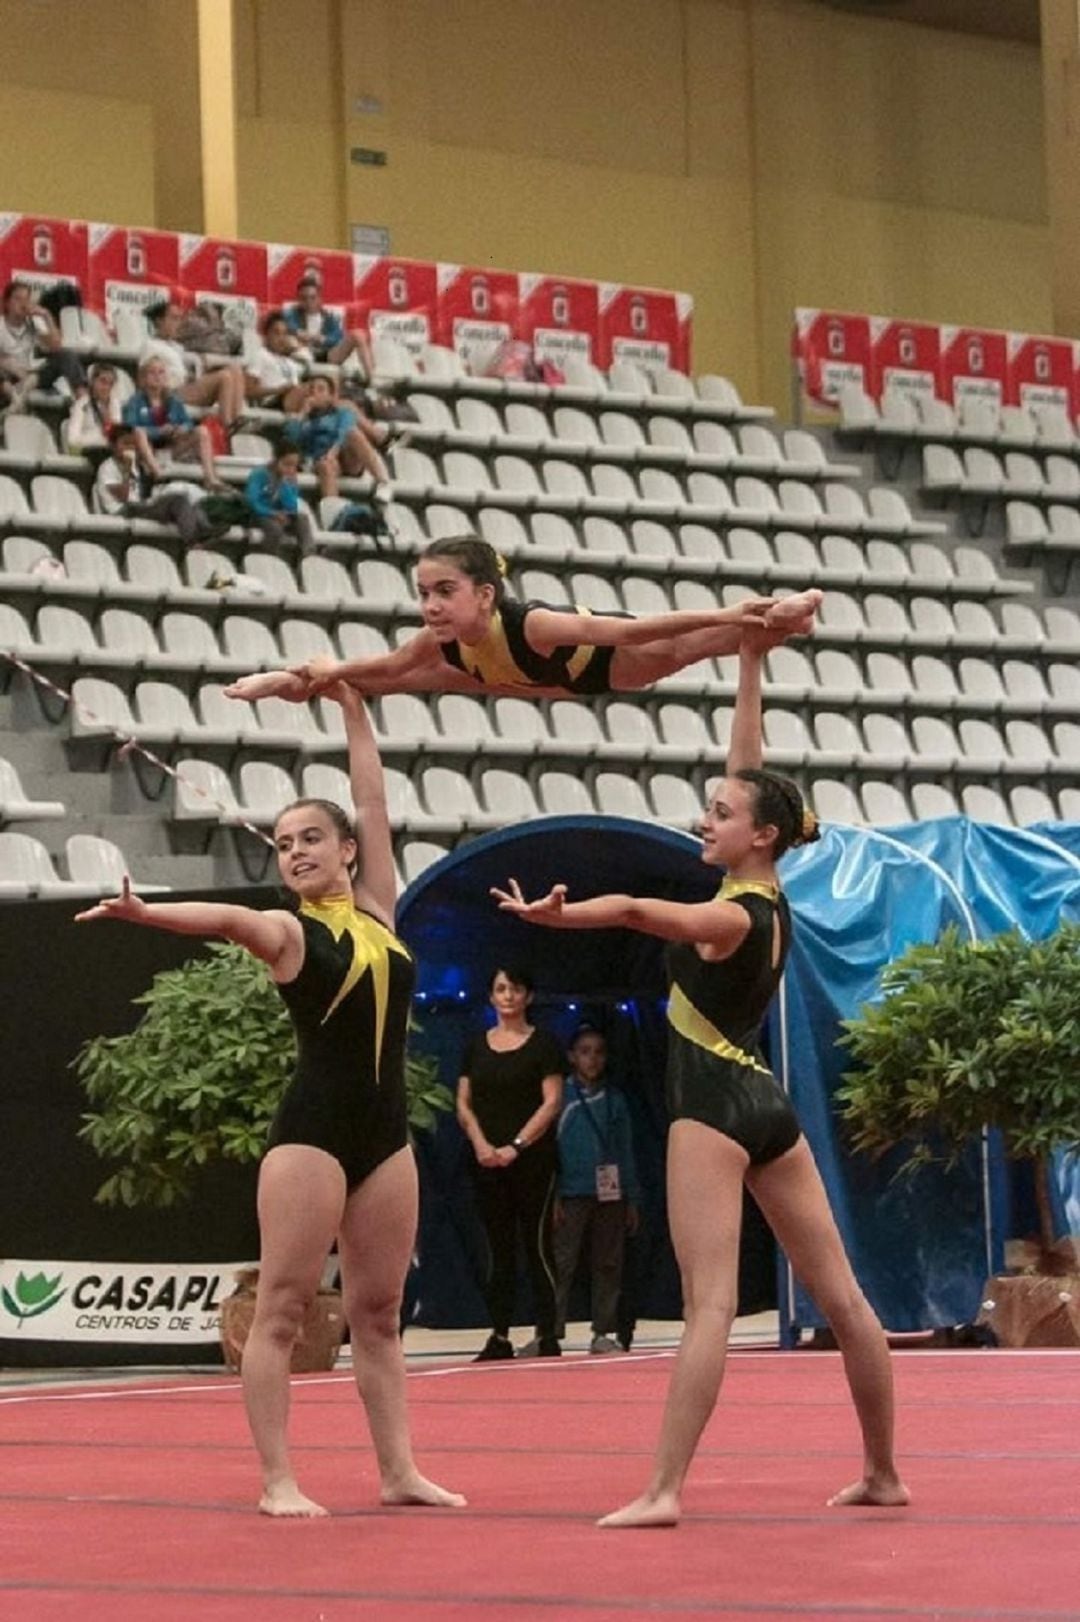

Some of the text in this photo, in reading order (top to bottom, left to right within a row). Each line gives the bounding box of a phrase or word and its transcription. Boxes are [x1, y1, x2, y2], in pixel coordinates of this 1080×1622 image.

[72, 1275, 220, 1312] CASAPL
[75, 1314, 160, 1330] CENTROS
[168, 1316, 194, 1331] DE
